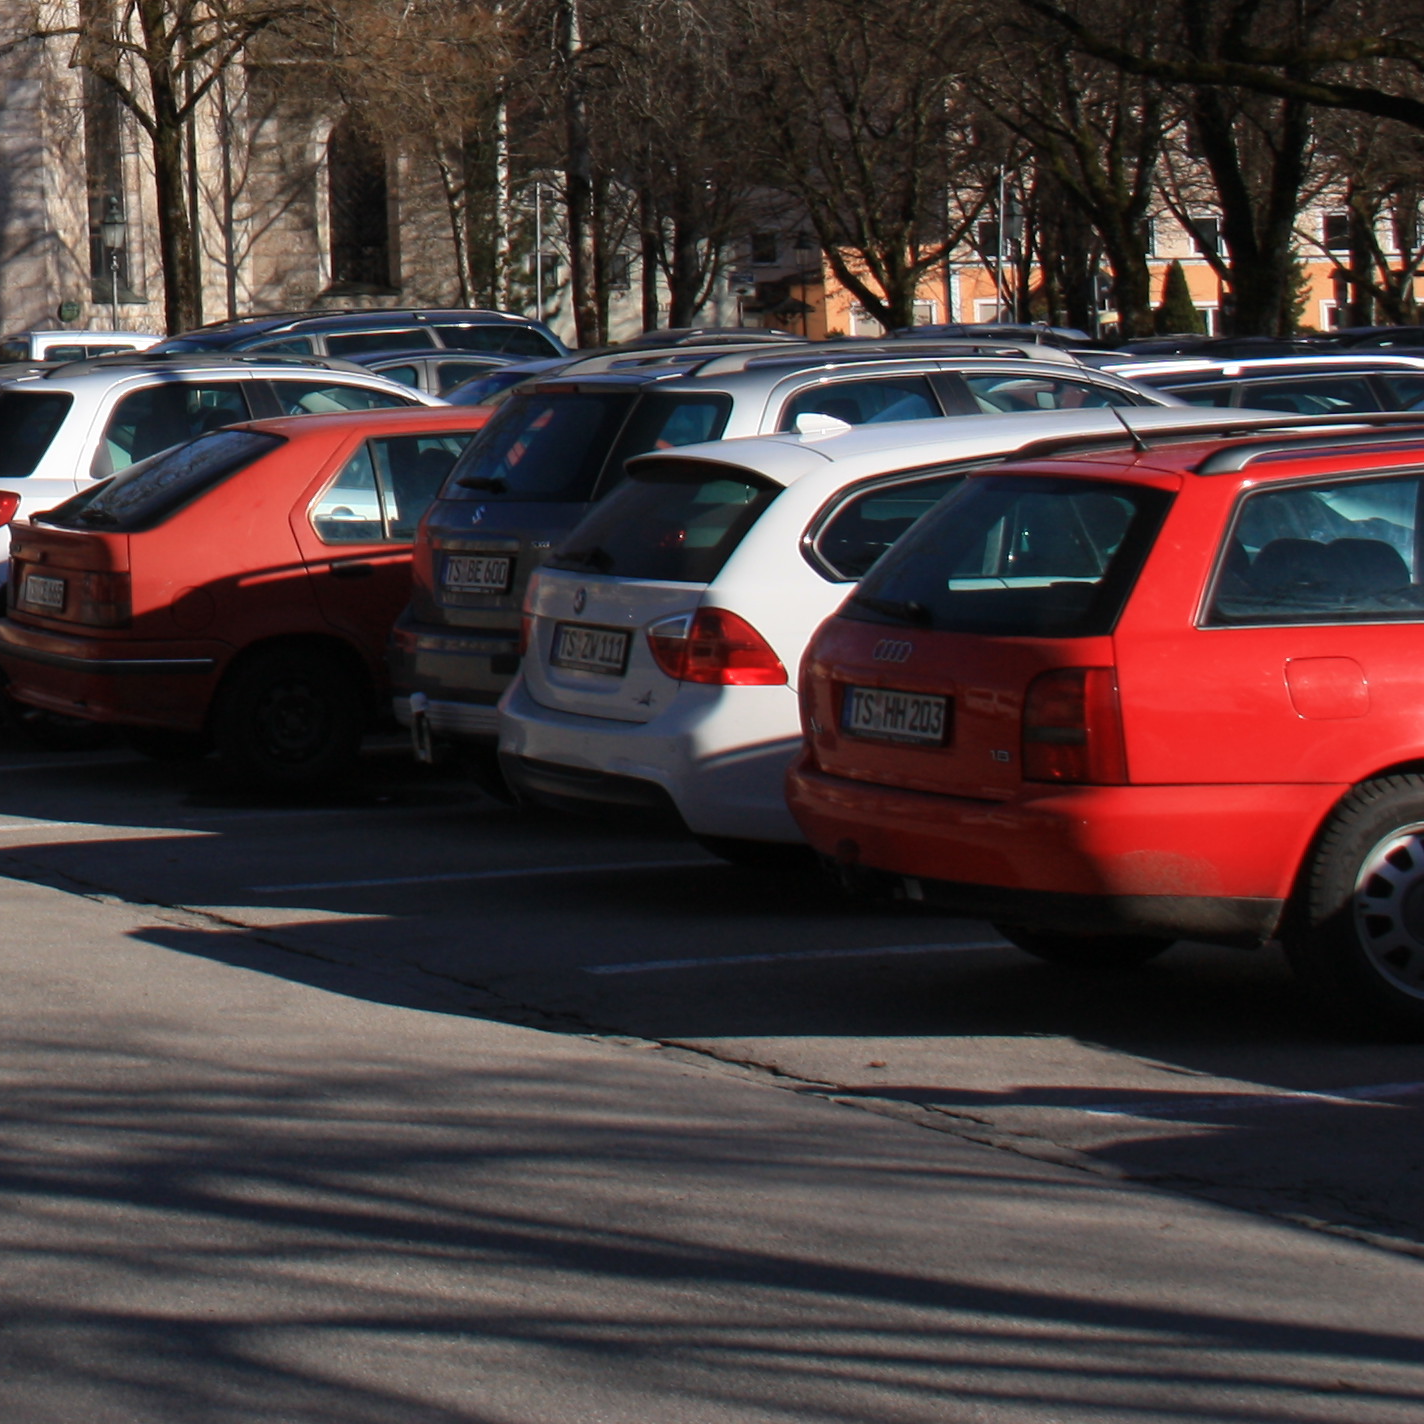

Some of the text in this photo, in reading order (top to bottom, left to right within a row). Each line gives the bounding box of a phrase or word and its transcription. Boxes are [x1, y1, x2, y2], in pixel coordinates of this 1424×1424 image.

[448, 559, 507, 585] TS BE 600
[561, 629, 577, 657] TS
[599, 635, 624, 664] 111
[854, 691, 874, 725] TS
[883, 695, 908, 730] HH
[909, 698, 944, 735] 203
